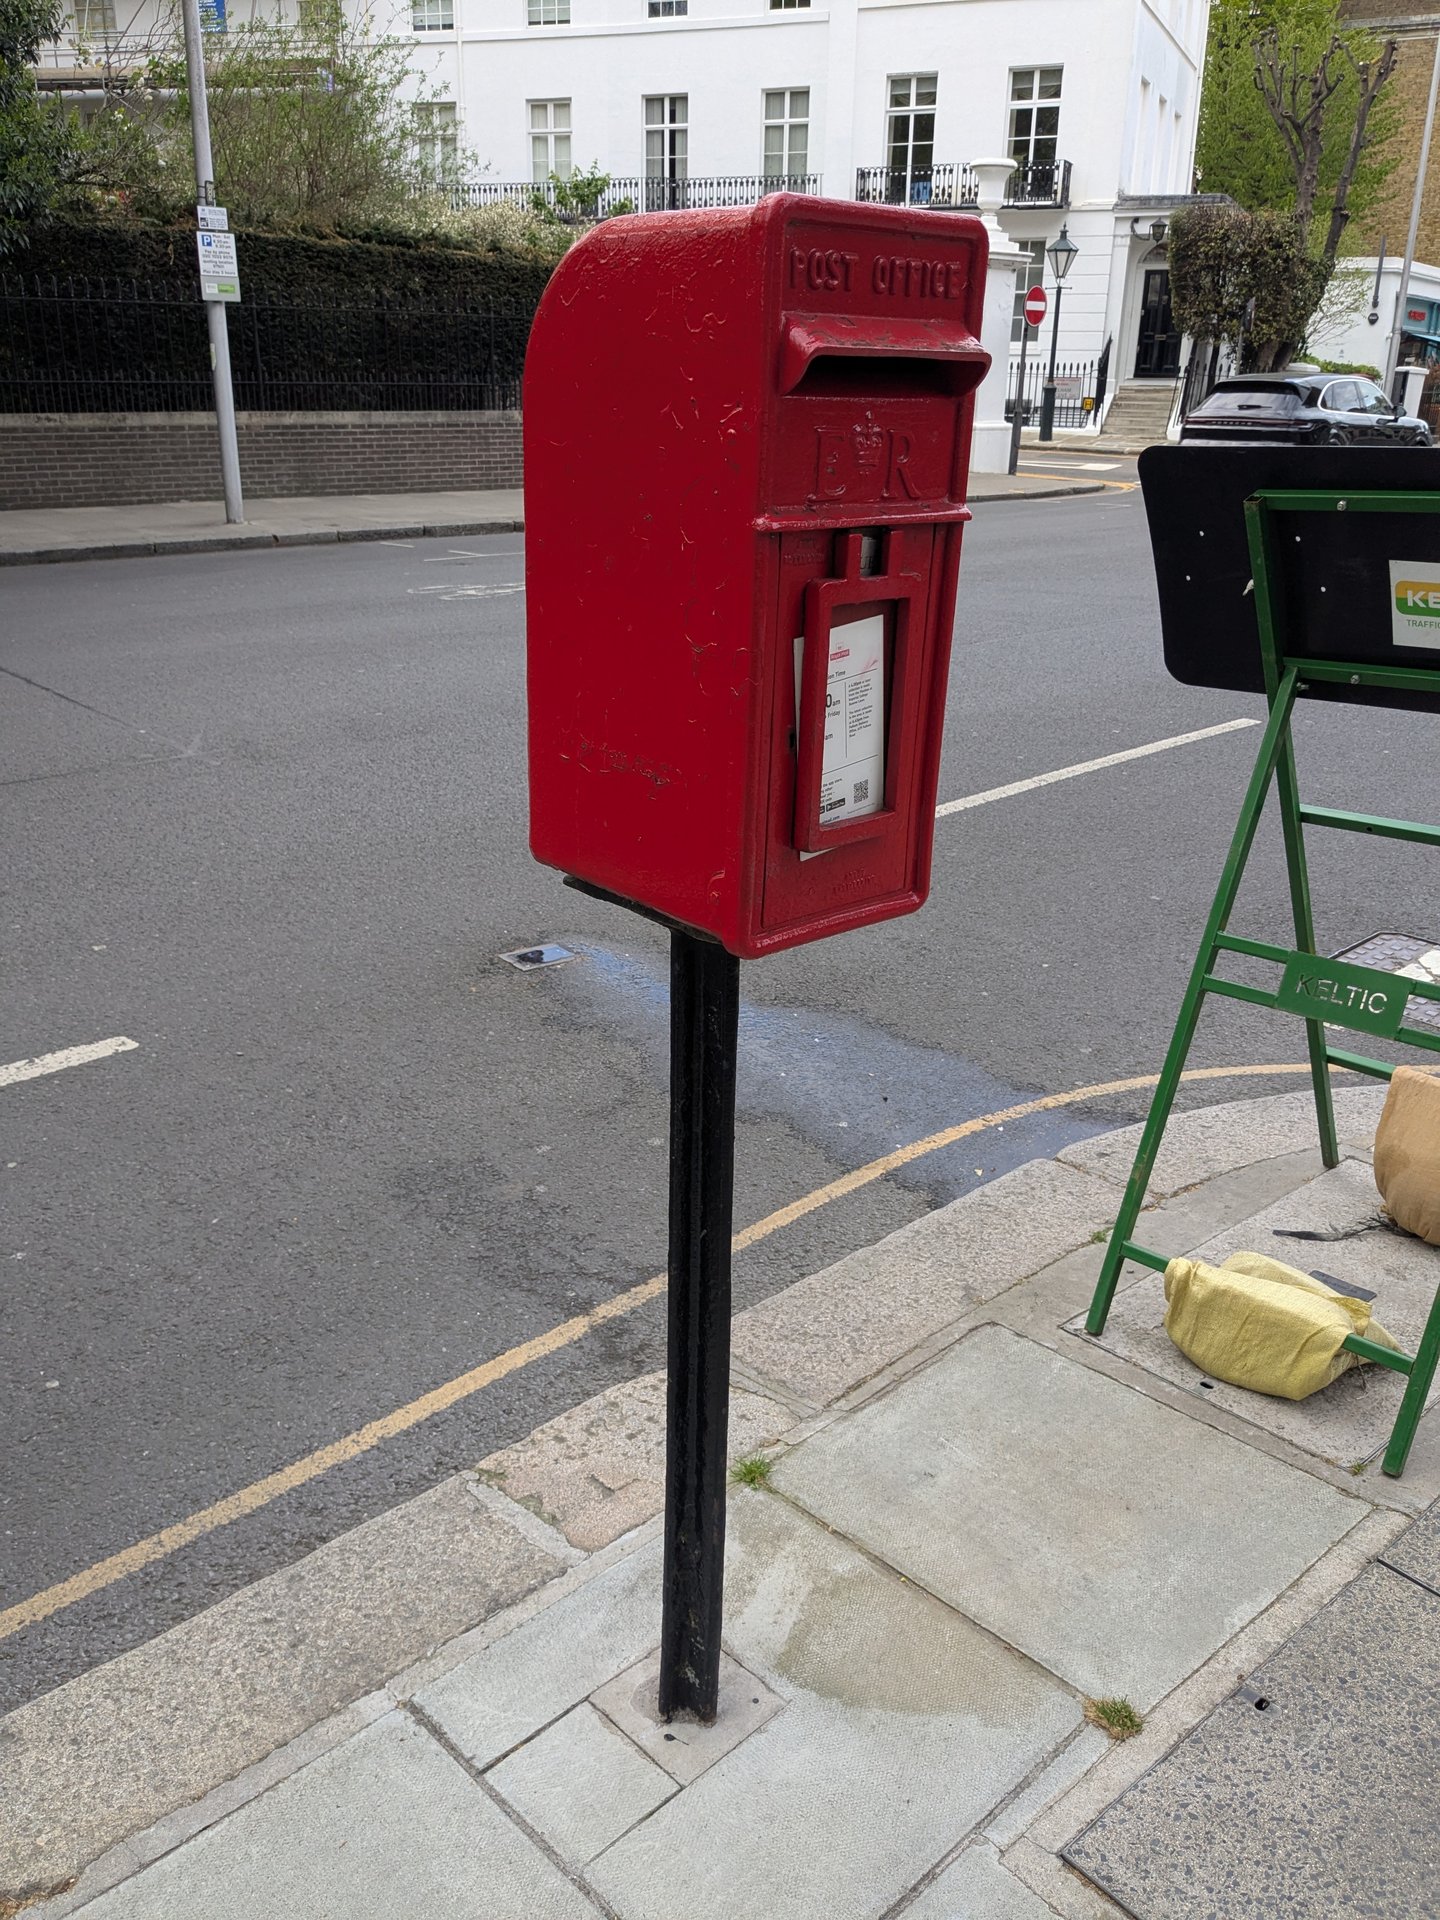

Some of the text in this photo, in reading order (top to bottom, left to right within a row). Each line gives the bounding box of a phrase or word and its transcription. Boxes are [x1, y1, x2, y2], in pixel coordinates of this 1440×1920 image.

[788, 245, 962, 300] POST OFFICE
[806, 424, 922, 502] E R
[1407, 590, 1440, 609] KE
[835, 670, 846, 678] Time
[828, 710, 840, 718] Friday
[1296, 974, 1388, 1014] KELTIC
